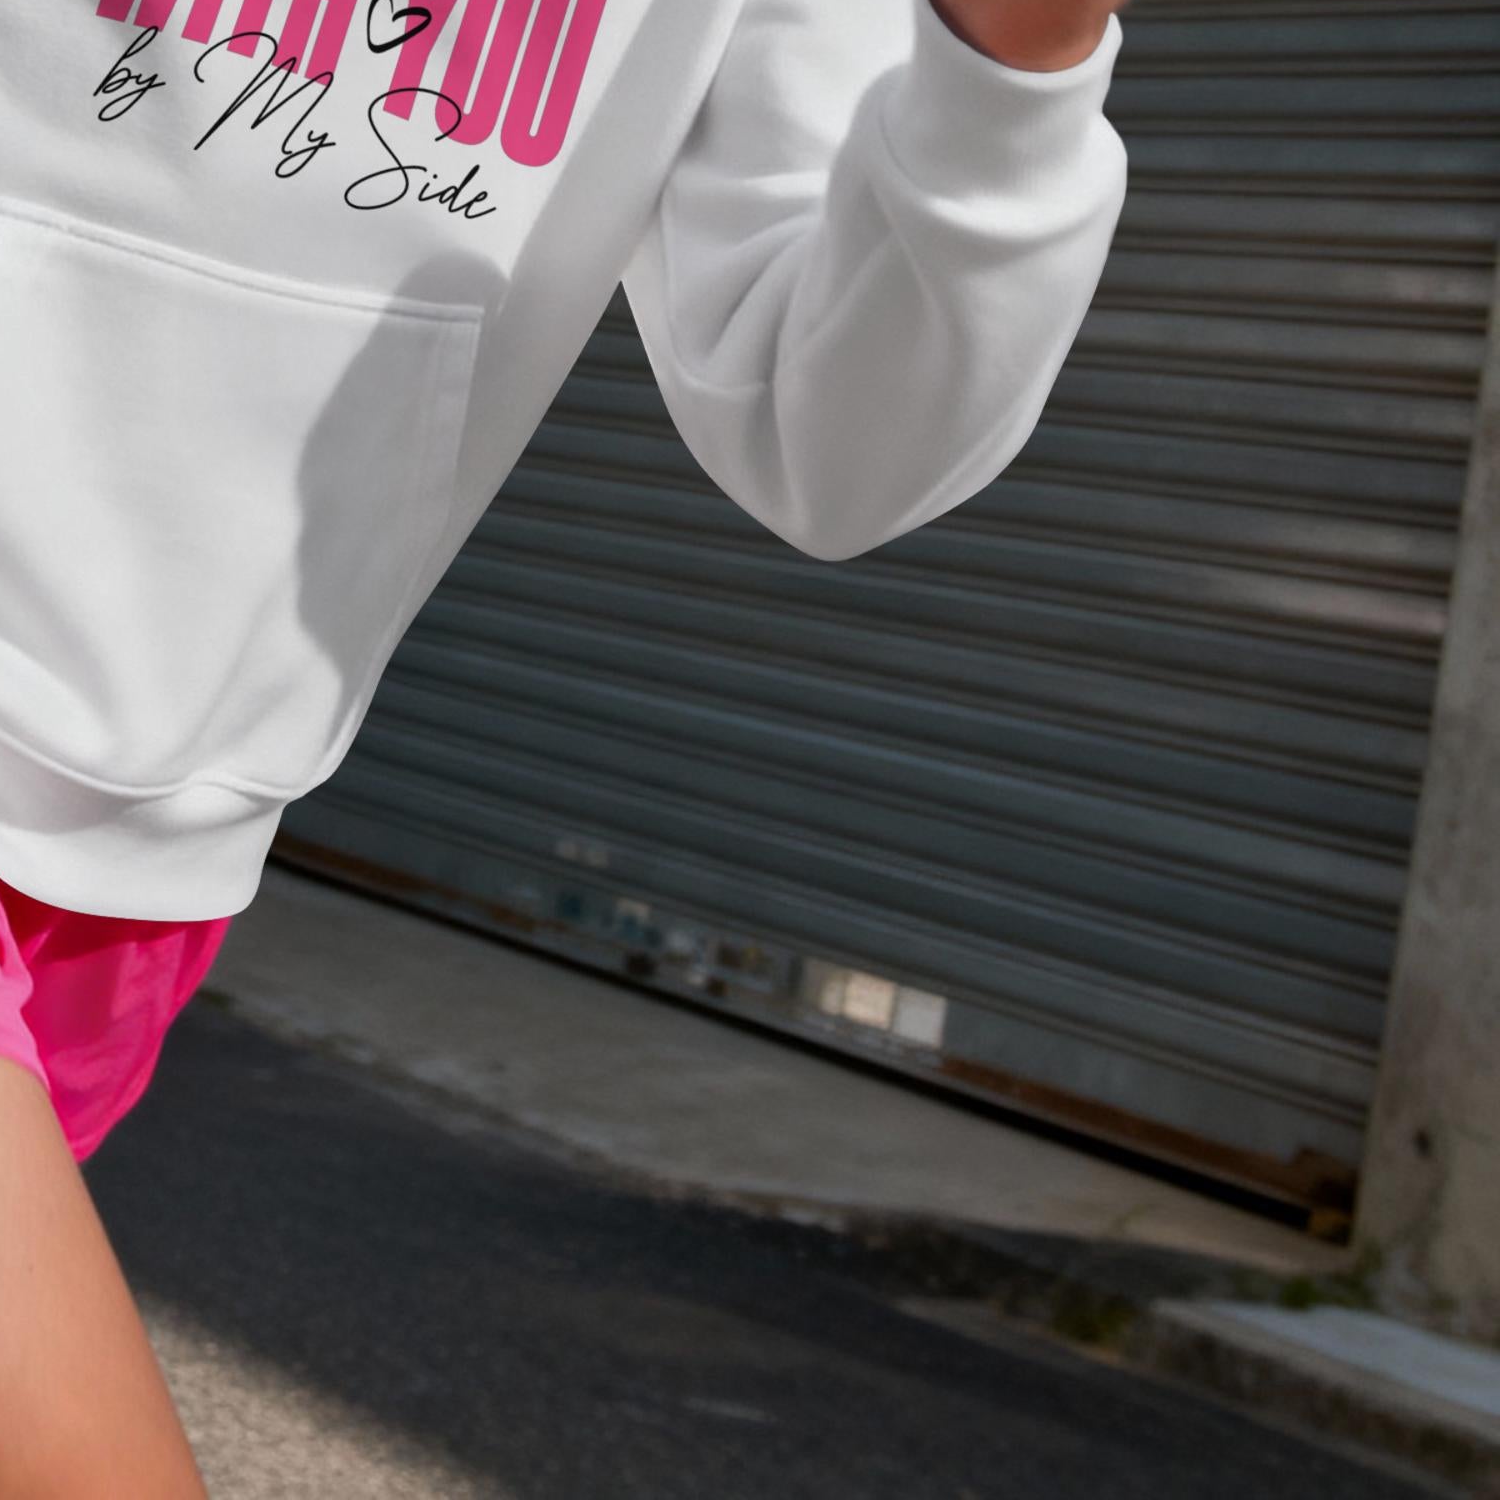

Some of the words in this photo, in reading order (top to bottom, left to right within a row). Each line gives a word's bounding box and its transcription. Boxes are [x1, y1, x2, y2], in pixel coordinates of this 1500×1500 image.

[93, 26, 166, 121] by
[193, 31, 336, 178] My
[344, 87, 497, 219] Side
